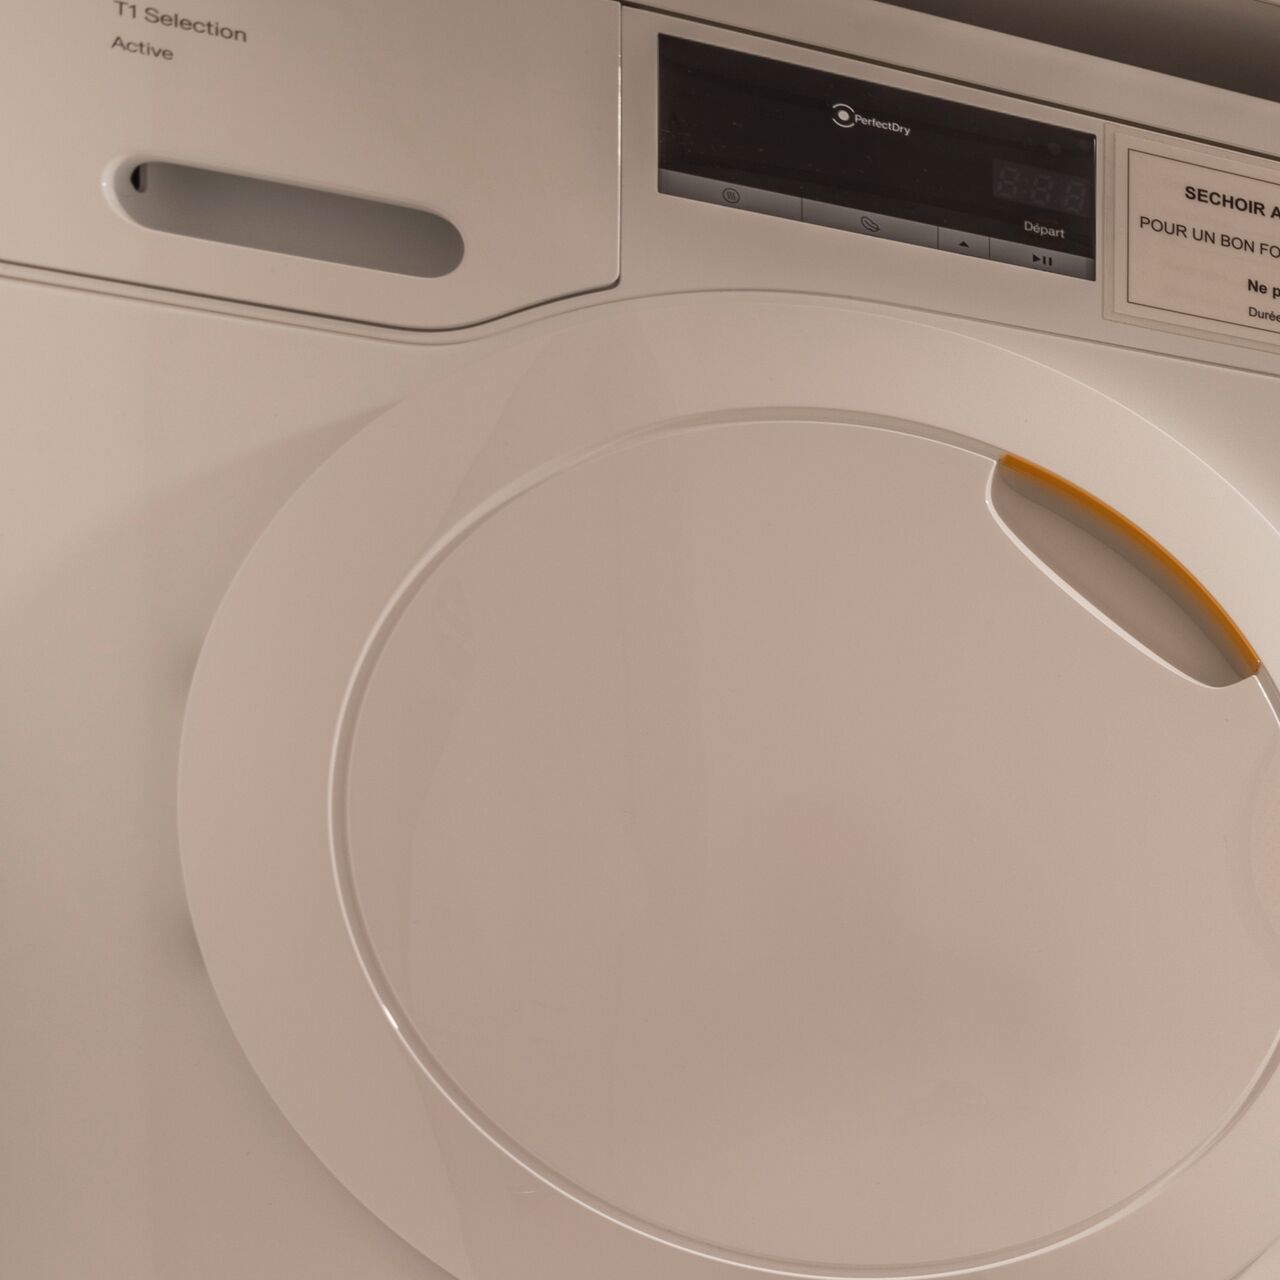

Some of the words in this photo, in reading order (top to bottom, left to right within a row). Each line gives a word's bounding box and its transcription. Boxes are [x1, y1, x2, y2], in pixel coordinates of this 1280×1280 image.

[113, 0, 136, 19] T1
[145, 7, 247, 42] Selection
[111, 36, 174, 60] Active
[854, 113, 911, 136] PerfectDry
[1184, 185, 1265, 216] SECHOIR
[1024, 220, 1065, 239] Départ
[1139, 216, 1188, 239] POUR
[1192, 228, 1216, 245] UN
[1220, 234, 1255, 253] BON
[1247, 278, 1268, 295] Ne
